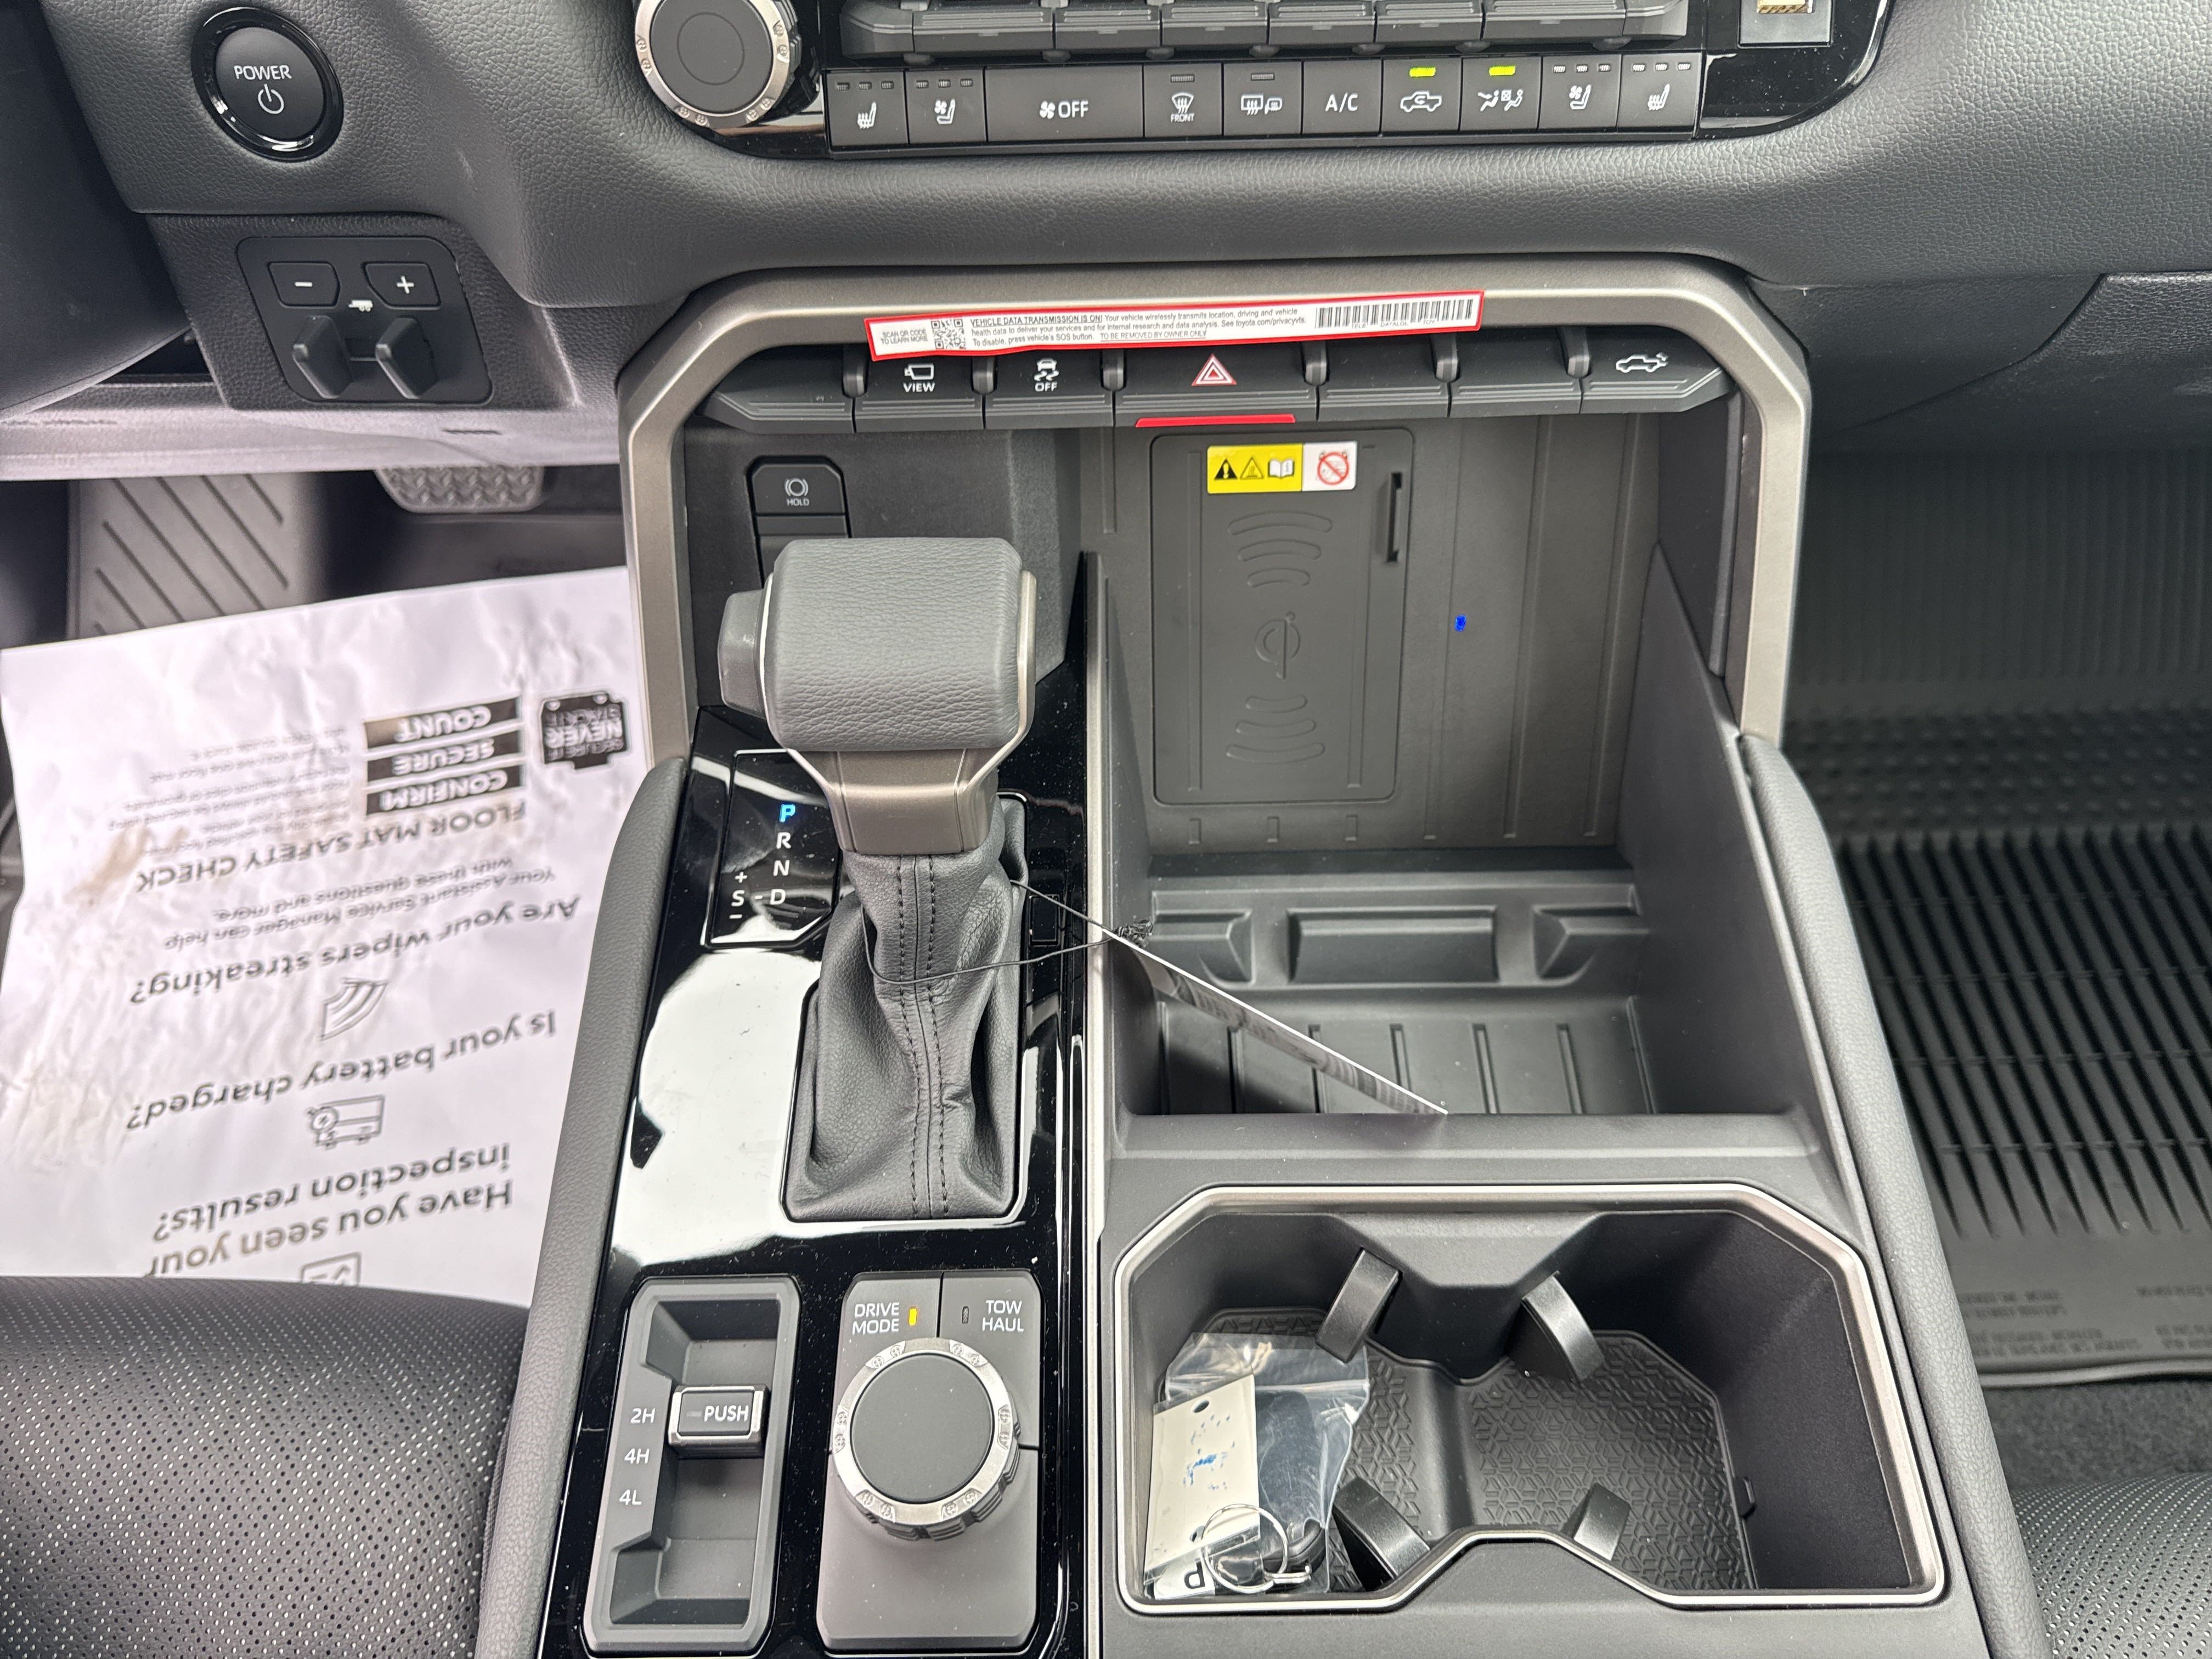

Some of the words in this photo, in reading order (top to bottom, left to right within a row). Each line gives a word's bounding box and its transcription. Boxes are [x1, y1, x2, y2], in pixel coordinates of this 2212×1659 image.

[234, 65, 292, 80] POWER
[1058, 100, 1089, 118] OFF
[1325, 94, 1358, 112] A/C
[1170, 114, 1195, 122] FRONT
[970, 318, 1002, 327] VEHICLE
[1003, 317, 1023, 325] DATA
[1024, 315, 1079, 325] TRANSMISSION
[1081, 315, 1088, 323] IS
[1121, 313, 1143, 321] vehicle
[1145, 313, 1176, 322] wirelessly
[1178, 312, 1207, 320] transmits
[1237, 310, 1259, 318] driving
[971, 329, 991, 337] health
[993, 328, 1007, 336] data
[1107, 323, 1131, 331] internal
[1132, 322, 1160, 330] research
[1162, 321, 1174, 330] and
[1221, 319, 1234, 328] See
[890, 336, 910, 345] LEARN
[910, 334, 929, 342] MORE
[910, 328, 927, 336] CODE
[973, 338, 981, 347] To
[982, 338, 1007, 346] disable,
[1008, 336, 1025, 345] press
[903, 382, 935, 393] VIEW
[1035, 382, 1058, 392] OFF
[394, 704, 492, 743] COUNT
[545, 718, 623, 749] NEVER
[391, 738, 495, 776] SECURE
[379, 769, 509, 811] CONFIRM
[430, 801, 526, 837] FLOOR
[779, 803, 795, 823] P
[358, 819, 421, 851] MAT
[776, 832, 791, 849] R
[243, 833, 353, 873] SAFETY
[135, 855, 238, 893] CHECK
[773, 860, 790, 876] N
[731, 889, 745, 906] S
[770, 889, 786, 905] D
[521, 895, 582, 922] Are
[437, 900, 514, 943] your
[319, 933, 432, 968] wipers
[130, 953, 312, 1005] streaking?
[530, 1009, 557, 1039] Is
[443, 1015, 521, 1063] your
[299, 1044, 436, 1092] battery
[125, 1075, 294, 1131] charged?
[311, 1143, 511, 1201] inspection
[418, 1180, 513, 1218] Have
[152, 1183, 301, 1242] results?
[338, 1193, 408, 1235] you
[241, 1216, 330, 1257] seen
[143, 1232, 230, 1278] your
[854, 1302, 900, 1318] DRIVE
[985, 1300, 1023, 1314] TOW
[852, 1318, 900, 1335] MODE
[982, 1317, 1024, 1332] HAUL
[630, 1408, 656, 1424] 2H
[704, 1405, 749, 1423] PUSH
[624, 1448, 650, 1464] 4H
[619, 1489, 642, 1505] 4L
